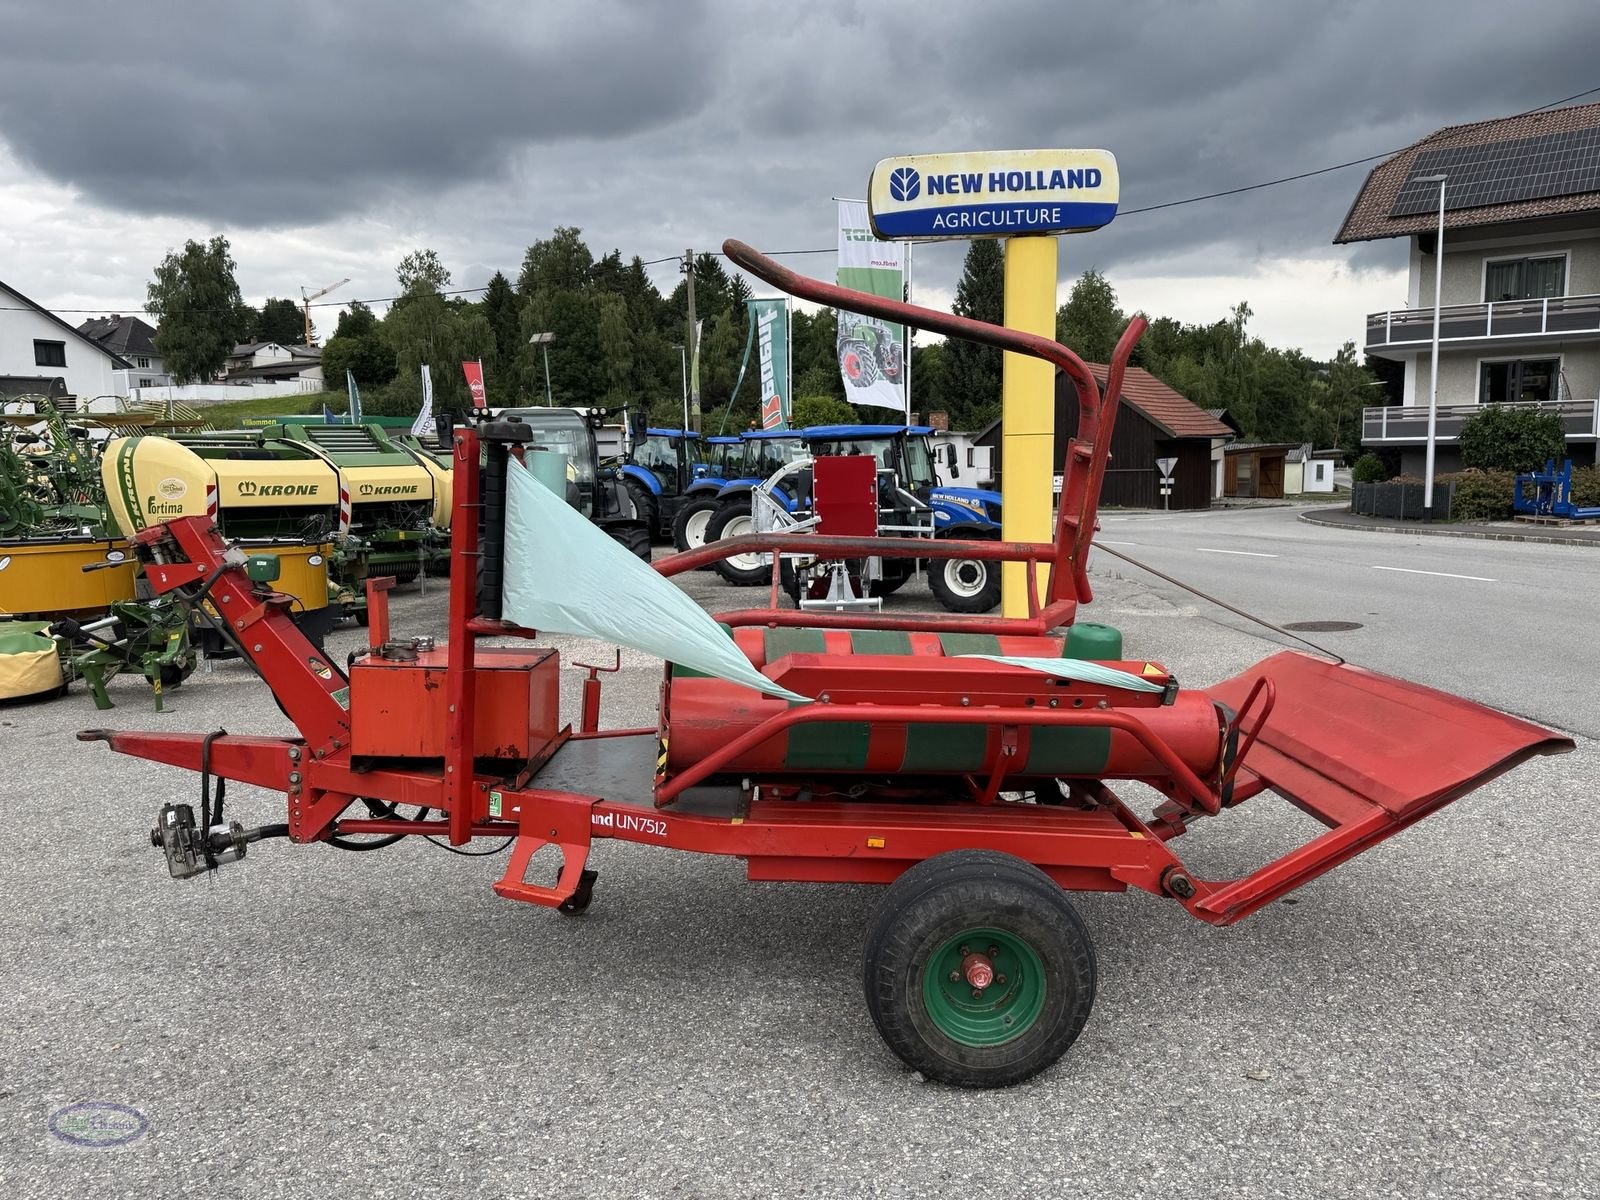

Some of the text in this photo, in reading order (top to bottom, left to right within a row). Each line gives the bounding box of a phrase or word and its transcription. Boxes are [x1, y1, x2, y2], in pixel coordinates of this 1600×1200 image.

[927, 168, 1102, 195] NEW HOLLAND
[932, 207, 1061, 229] AGRICULTURE
[124, 446, 141, 516] KRONE
[258, 485, 319, 496] KRONE
[374, 486, 418, 495] KRONE
[945, 494, 969, 504] HOLLAND
[616, 813, 668, 837] UN7512
